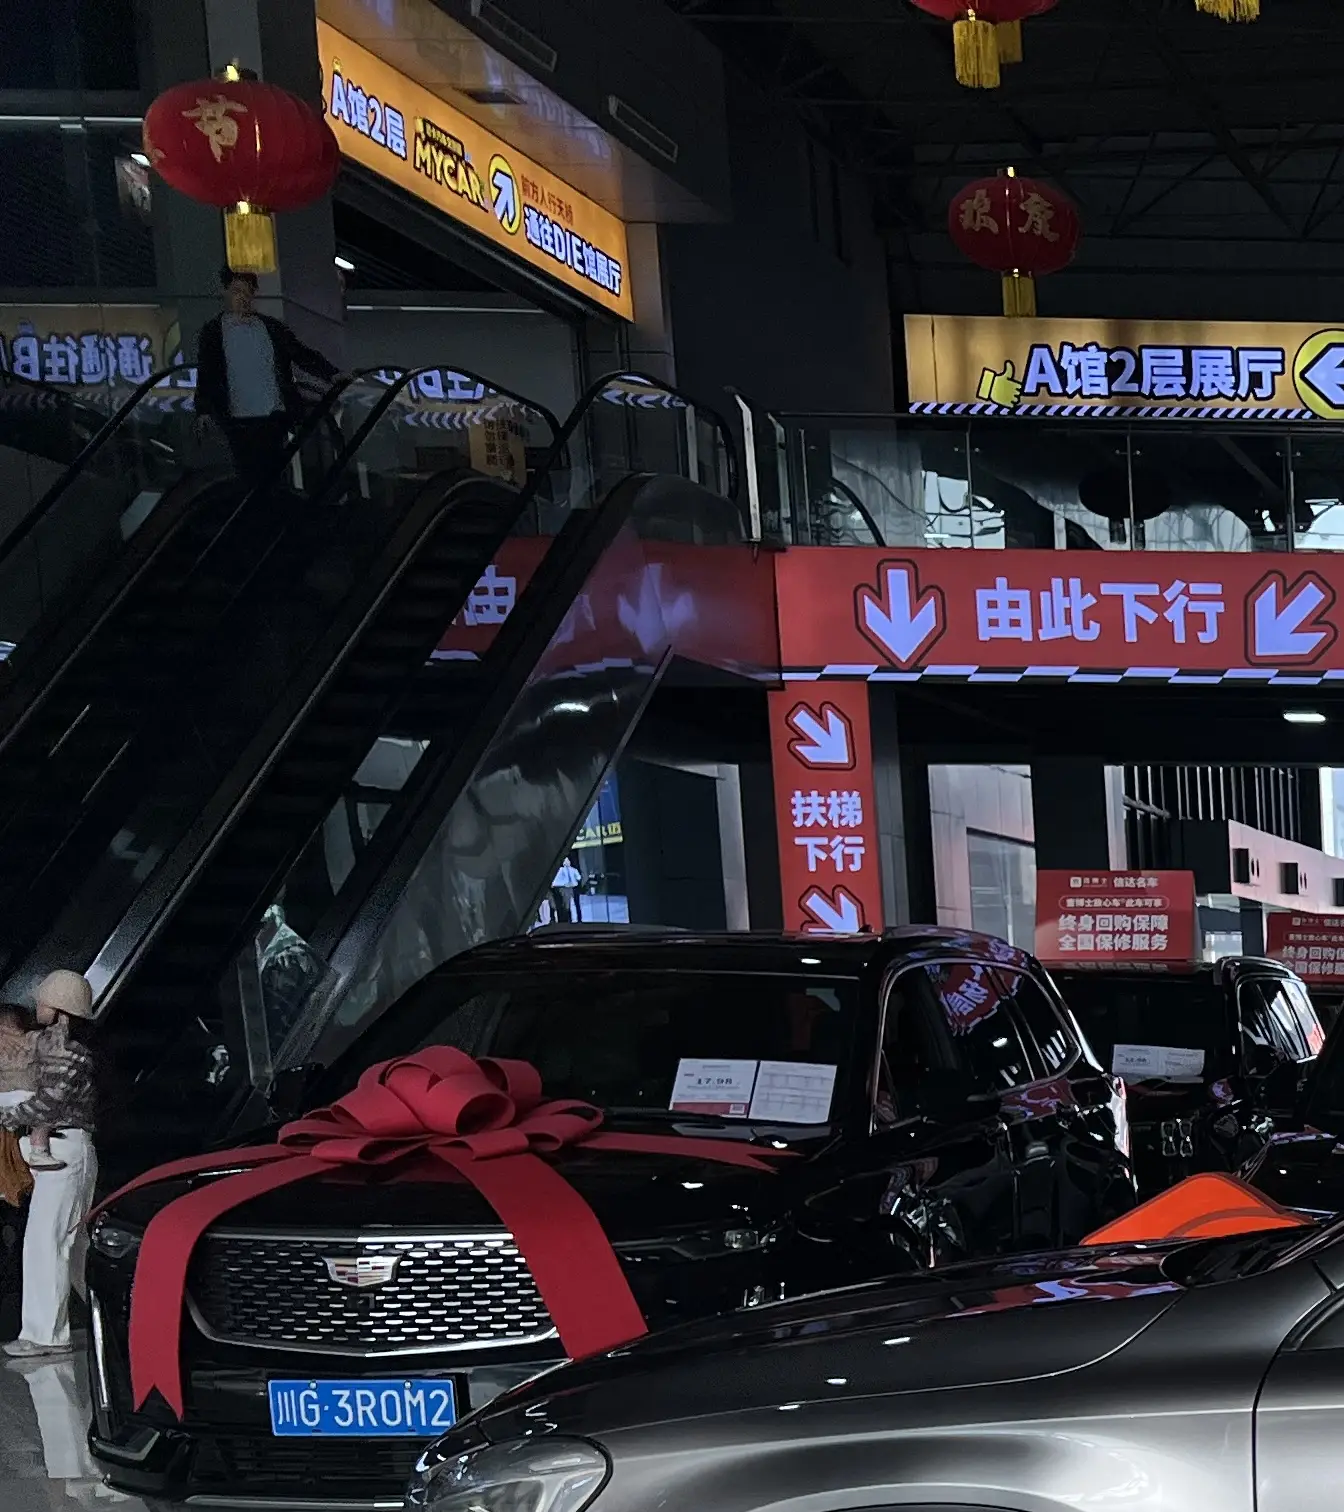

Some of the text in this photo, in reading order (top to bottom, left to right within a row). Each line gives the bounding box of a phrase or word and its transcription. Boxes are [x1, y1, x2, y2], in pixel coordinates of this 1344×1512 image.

[414, 138, 488, 210] MYCAR
[1024, 347, 1285, 400] A馆2层展厅
[976, 578, 1225, 644] 由此下行
[791, 790, 863, 828] 扶梯
[795, 835, 865, 872] 下行
[1113, 876, 1159, 888] 信达名车
[1058, 914, 1169, 931] 终身回购保障
[1058, 933, 1169, 951] 全国保修服务
